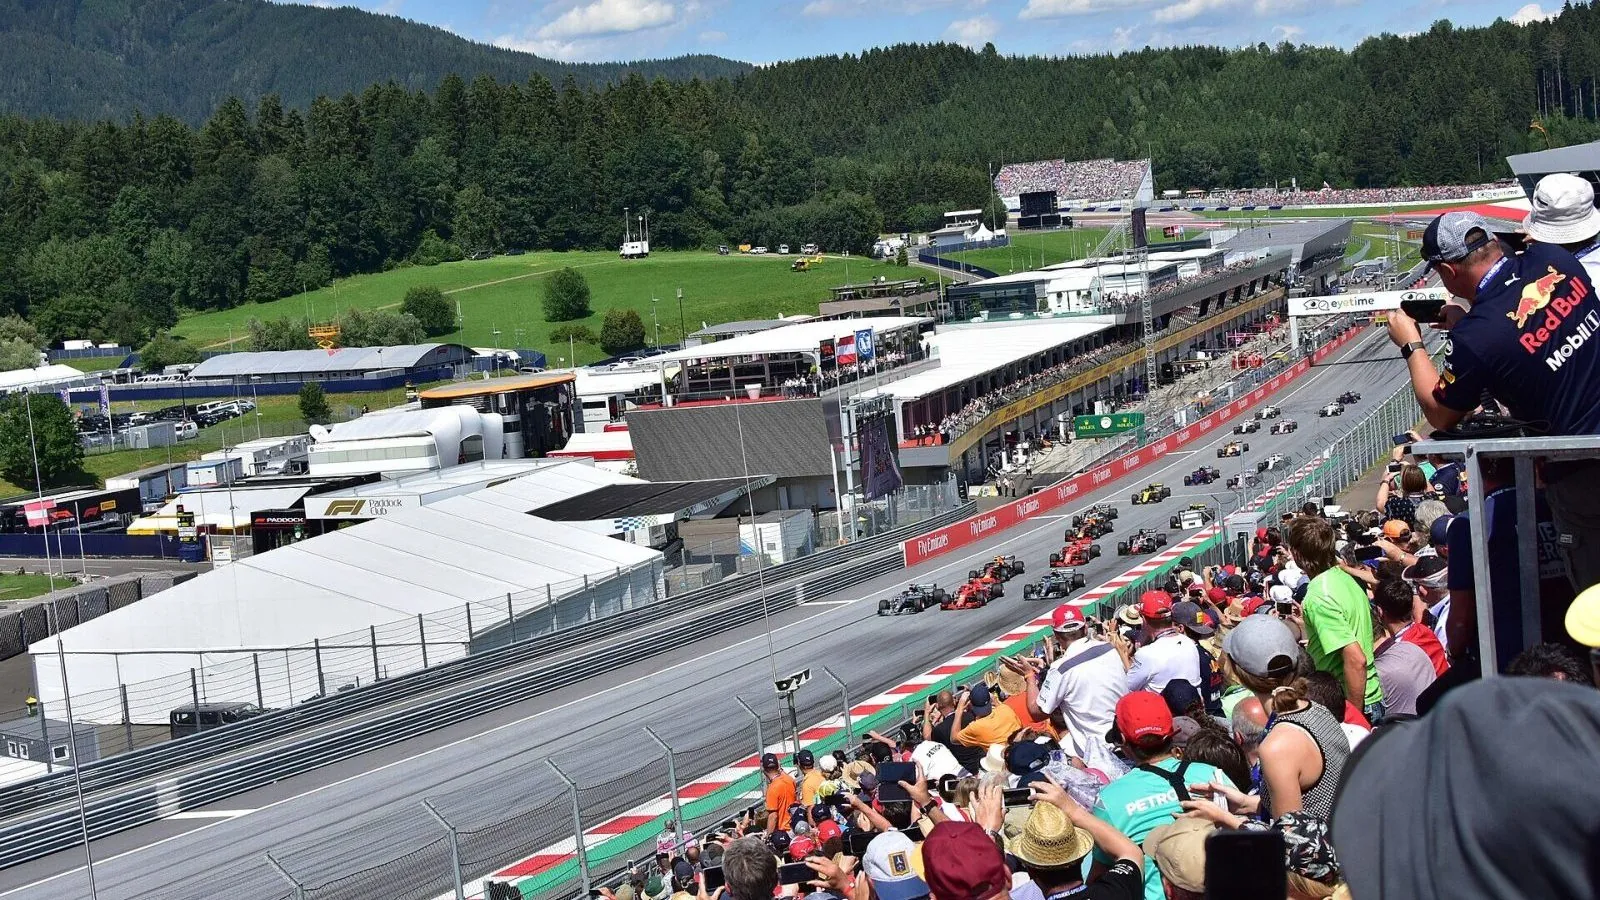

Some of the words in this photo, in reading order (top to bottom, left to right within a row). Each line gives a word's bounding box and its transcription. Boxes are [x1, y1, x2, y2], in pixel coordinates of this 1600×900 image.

[1331, 297, 1374, 309] eyetime
[1519, 308, 1561, 354] Red
[1551, 276, 1588, 318] Bull
[1545, 322, 1592, 372] Mobil
[1063, 482, 1078, 496] Emirates
[369, 499, 403, 507] Paddock
[370, 507, 388, 515] Club
[1016, 504, 1024, 518] Fly
[1023, 498, 1040, 515] Emirates
[970, 520, 979, 536] Fly
[979, 516, 997, 532] Emirates
[918, 540, 928, 556] Fly
[927, 533, 949, 552] Emirates
